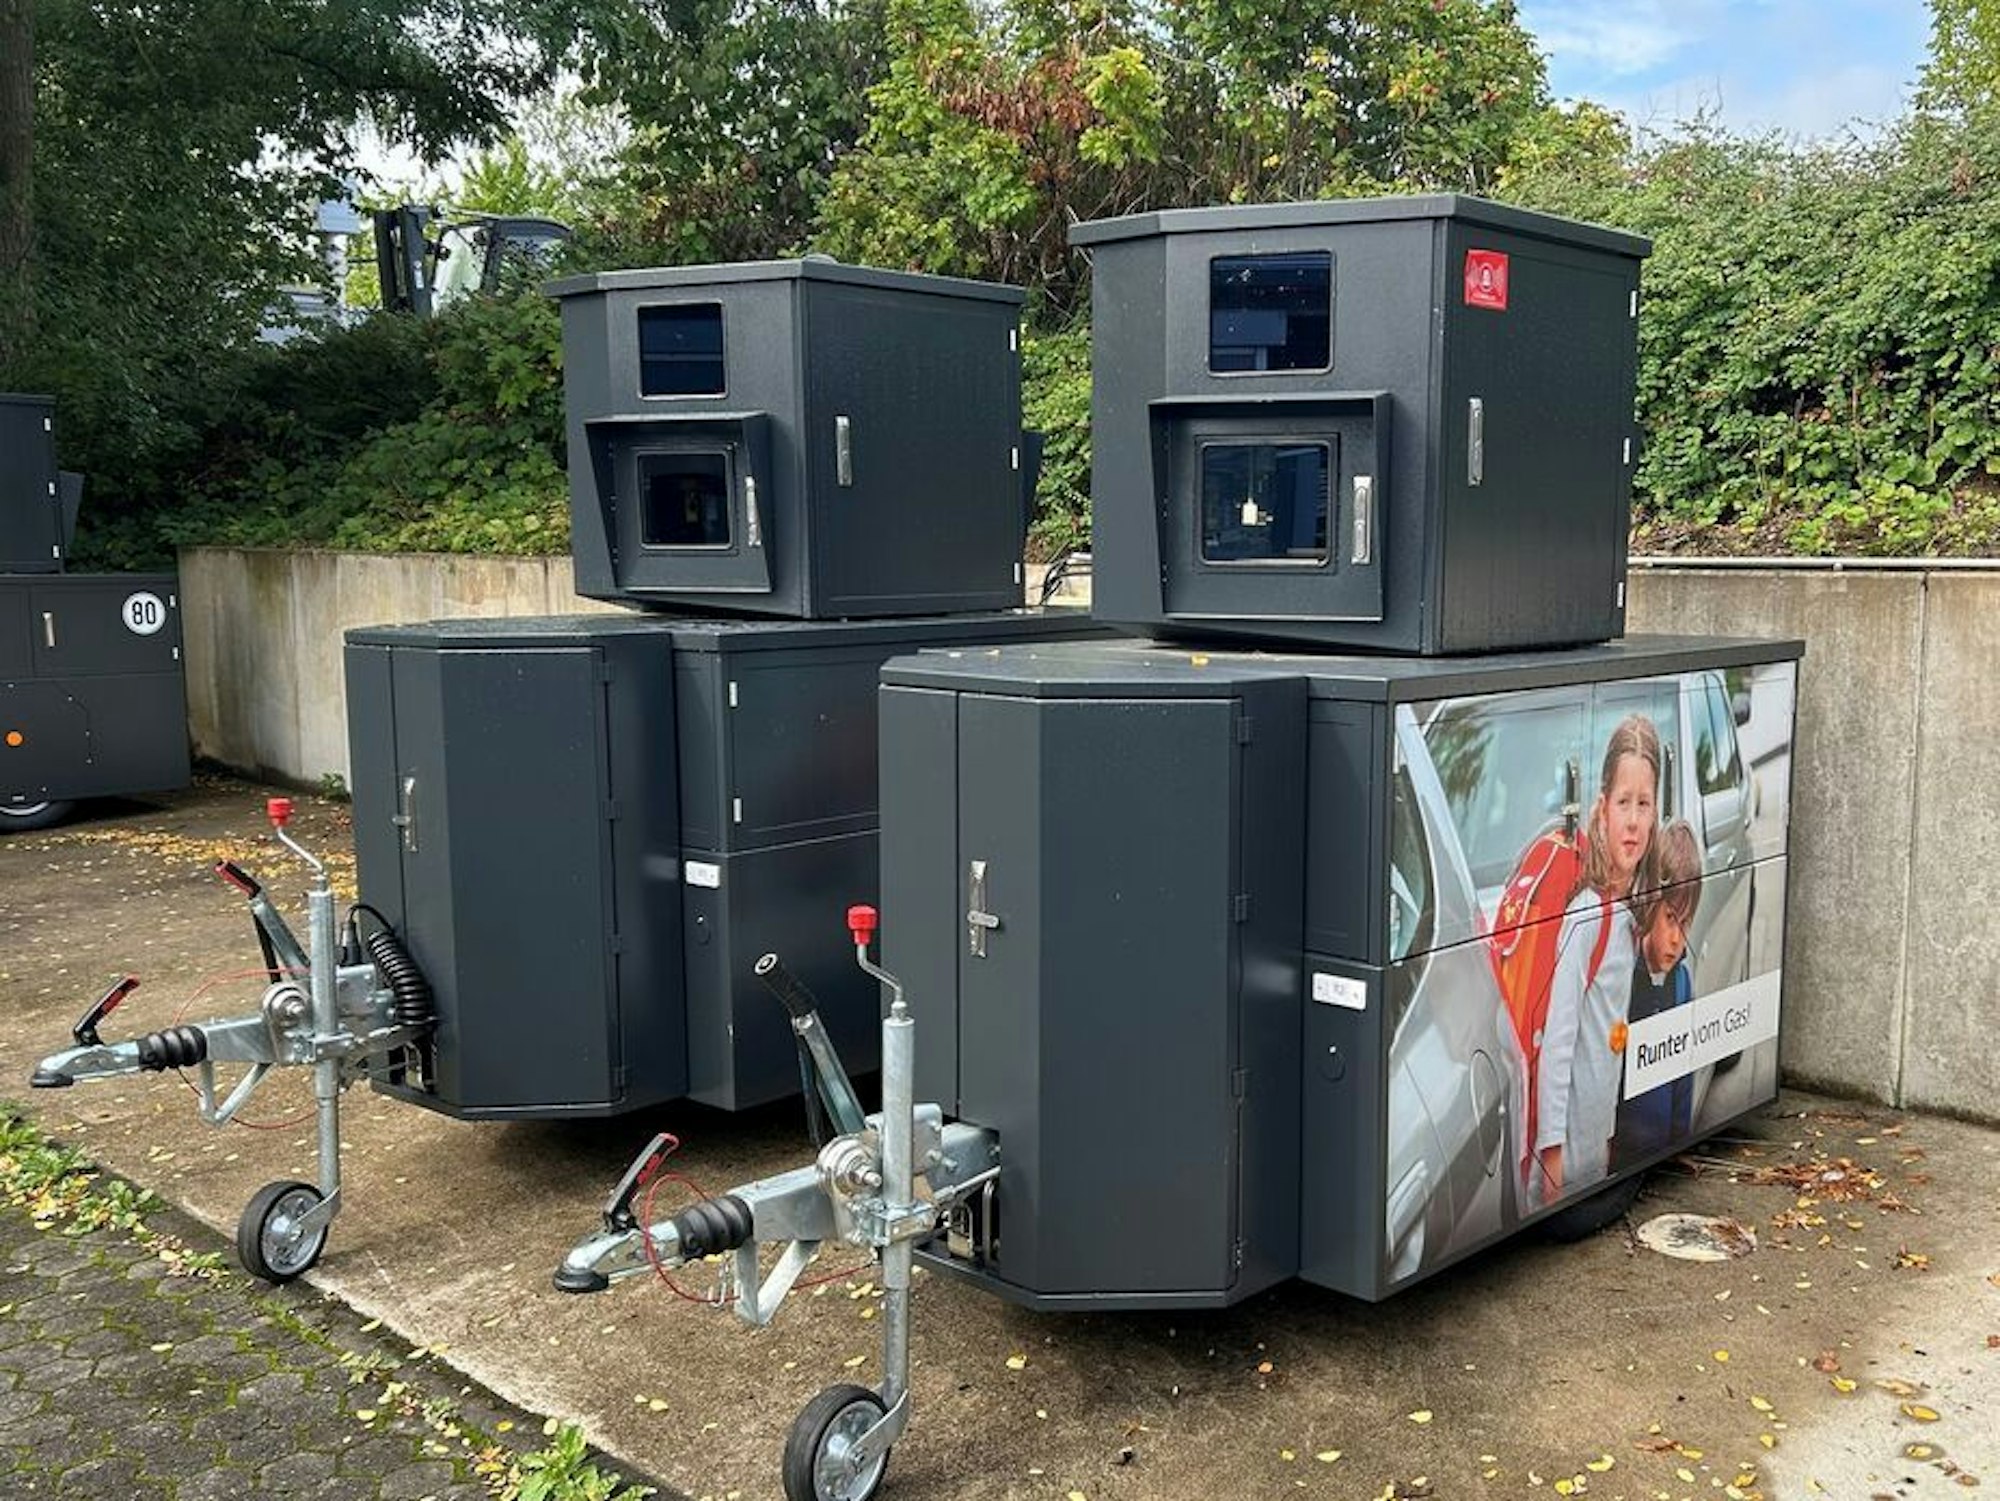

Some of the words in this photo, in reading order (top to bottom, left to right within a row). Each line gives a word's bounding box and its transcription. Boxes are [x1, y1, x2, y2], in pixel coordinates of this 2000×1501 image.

[132, 601, 156, 625] 80
[1637, 1029, 1689, 1069] Runter
[1691, 1018, 1721, 1046] vom
[1724, 1002, 1752, 1033] Gas!
